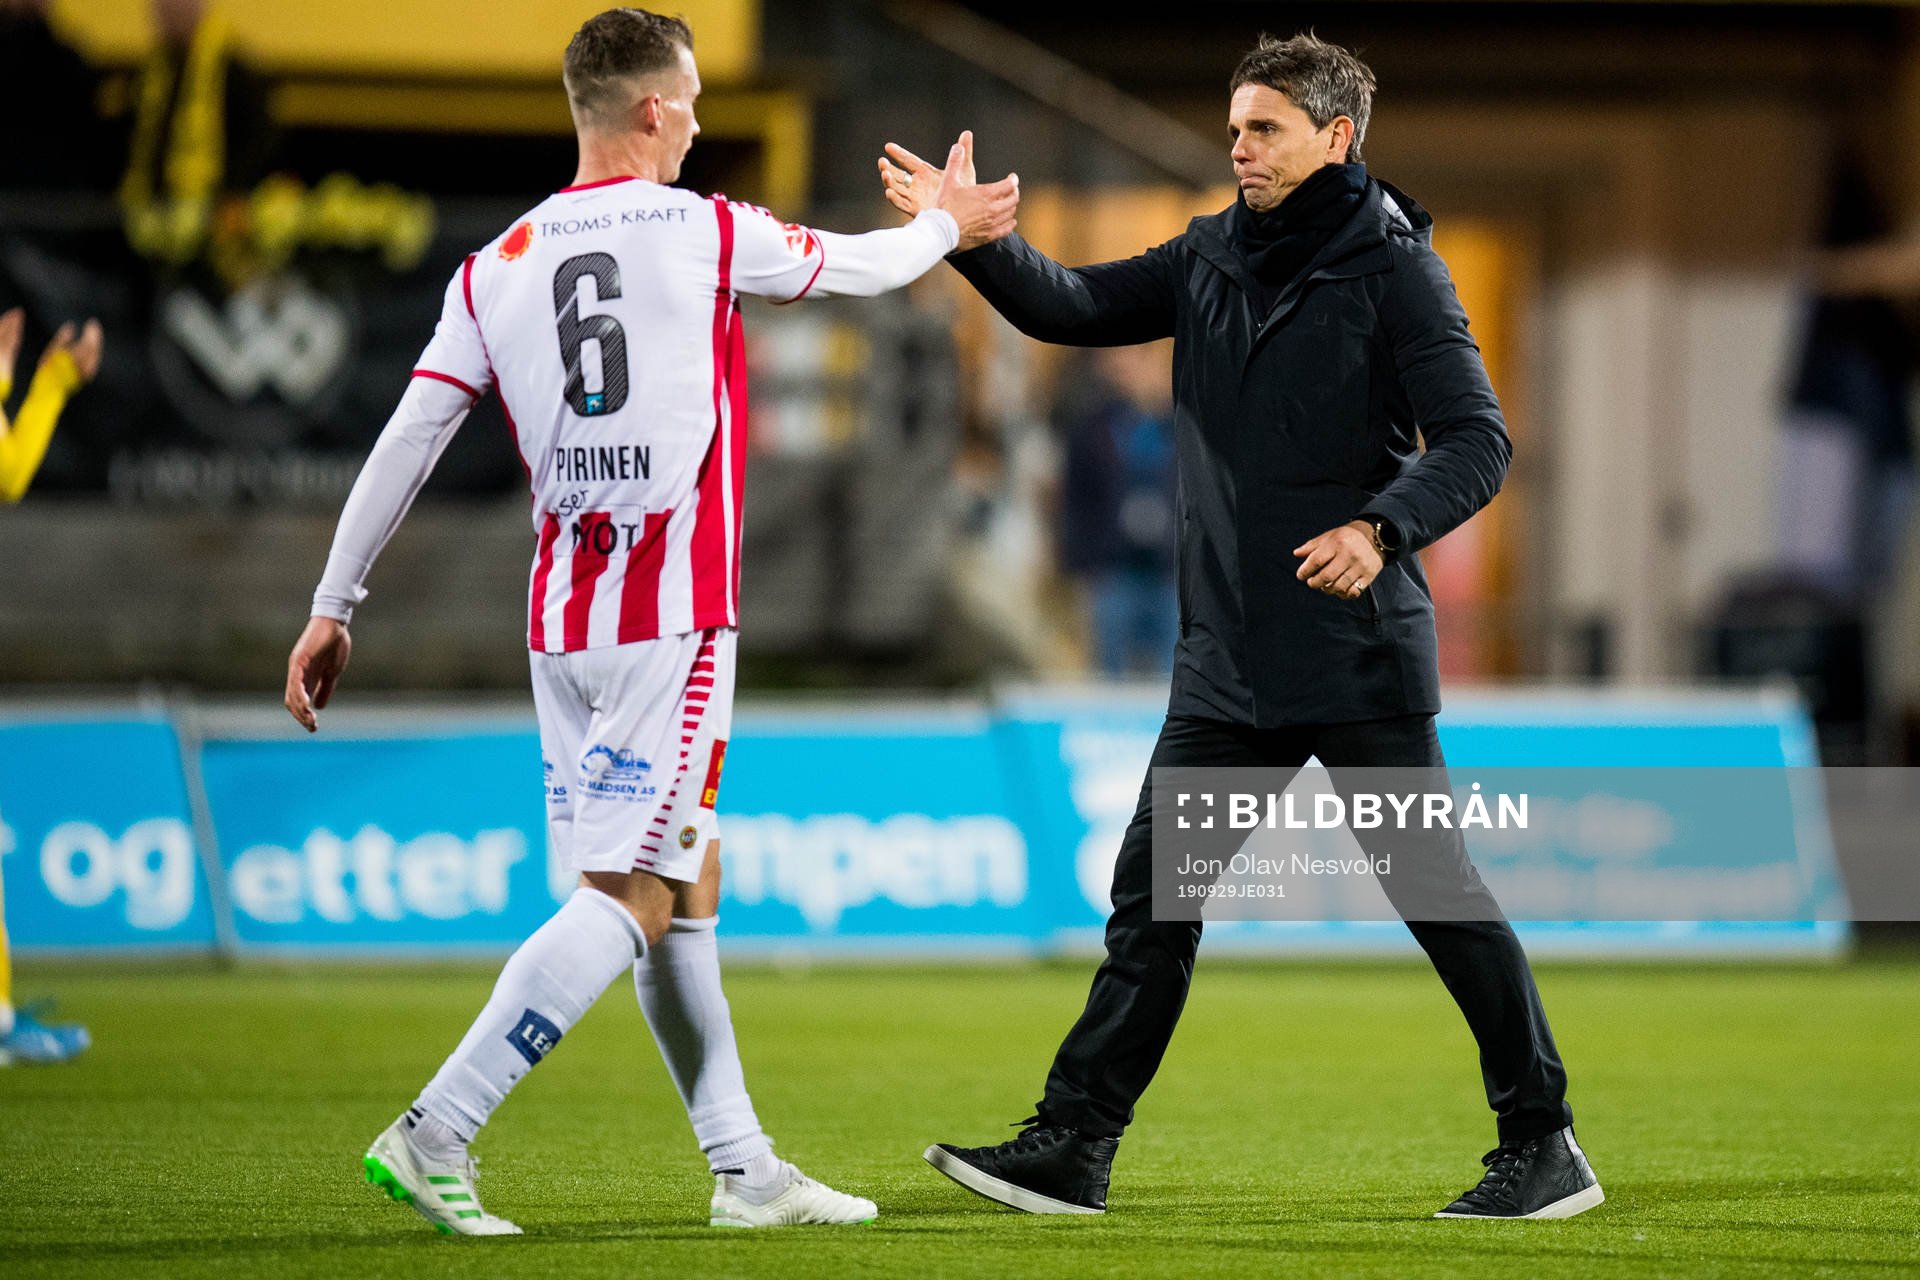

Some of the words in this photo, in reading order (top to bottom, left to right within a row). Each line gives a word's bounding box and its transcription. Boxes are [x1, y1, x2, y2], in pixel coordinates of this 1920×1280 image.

[541, 213, 612, 238] TROMS
[621, 208, 687, 224] KRAFT
[557, 252, 629, 416] 6
[556, 446, 650, 482] PIRINEN
[40, 818, 194, 931] og
[231, 824, 527, 922] etter
[718, 813, 1027, 930] mpen
